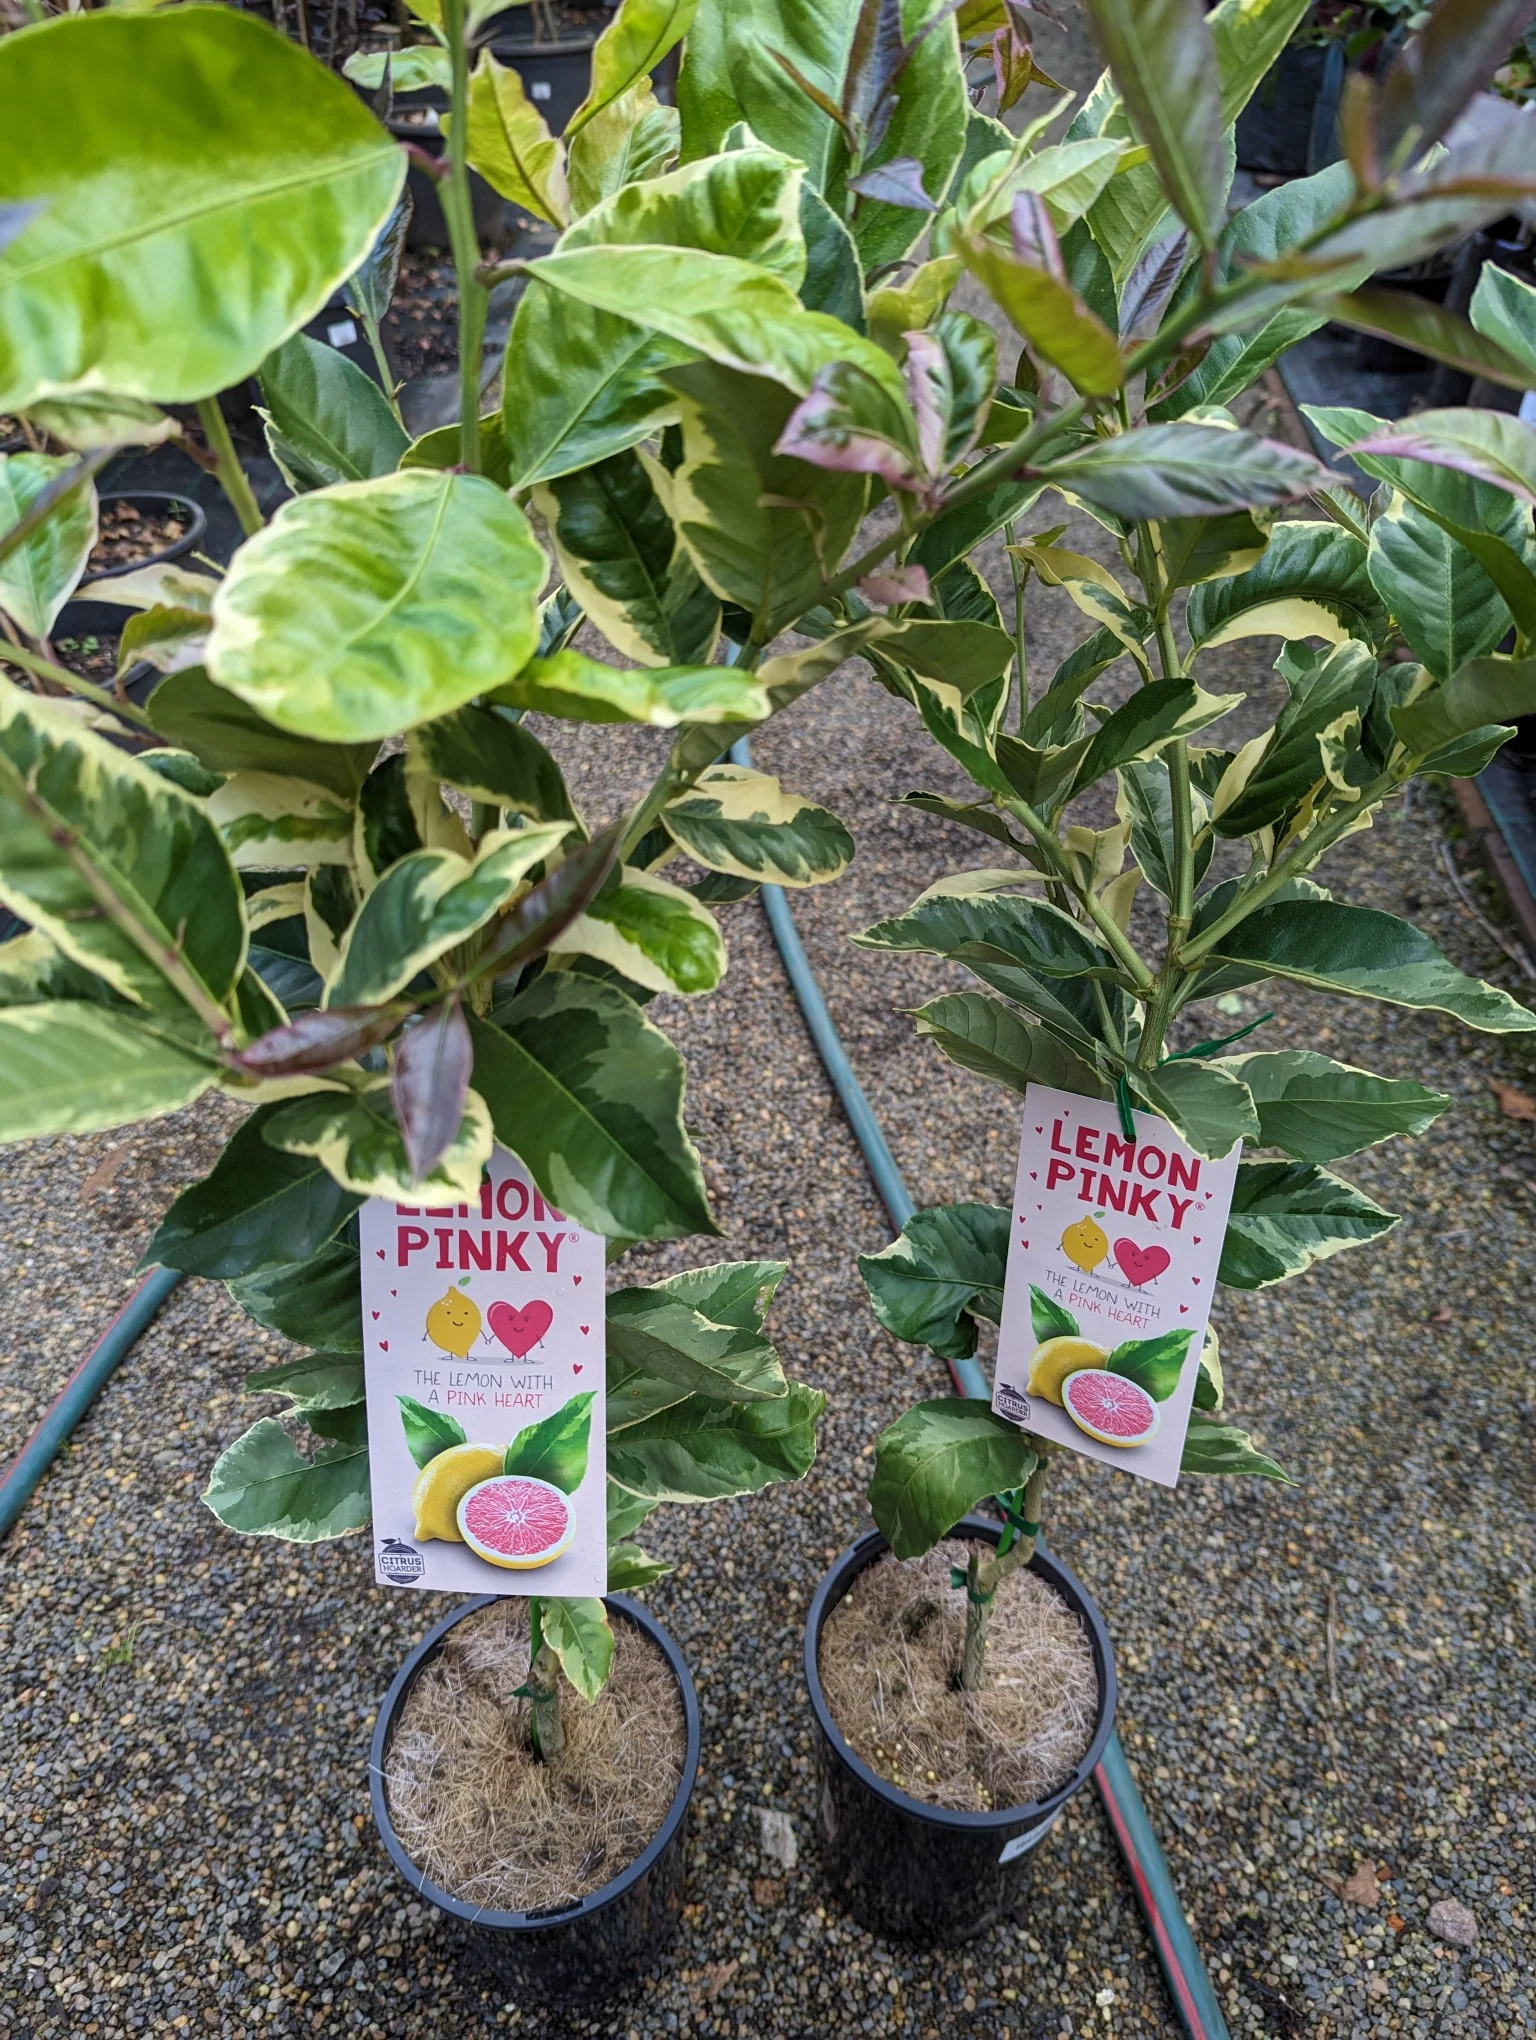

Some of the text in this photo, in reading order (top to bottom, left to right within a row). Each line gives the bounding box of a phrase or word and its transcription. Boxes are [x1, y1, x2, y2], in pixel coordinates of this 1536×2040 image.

[1050, 1118, 1202, 1192] LEMON
[1045, 1269, 1162, 1319] THE LEMON WITH
[1053, 1288, 1151, 1330] A PINK HEART
[413, 1369, 554, 1391] THE LEMON WITH
[427, 1388, 544, 1409] A PINK HEART
[997, 1394, 1029, 1412] CITRUS
[998, 1400, 1028, 1417] HOARDER
[381, 1556, 421, 1565] CITRUS
[383, 1565, 422, 1573] HOARDER
